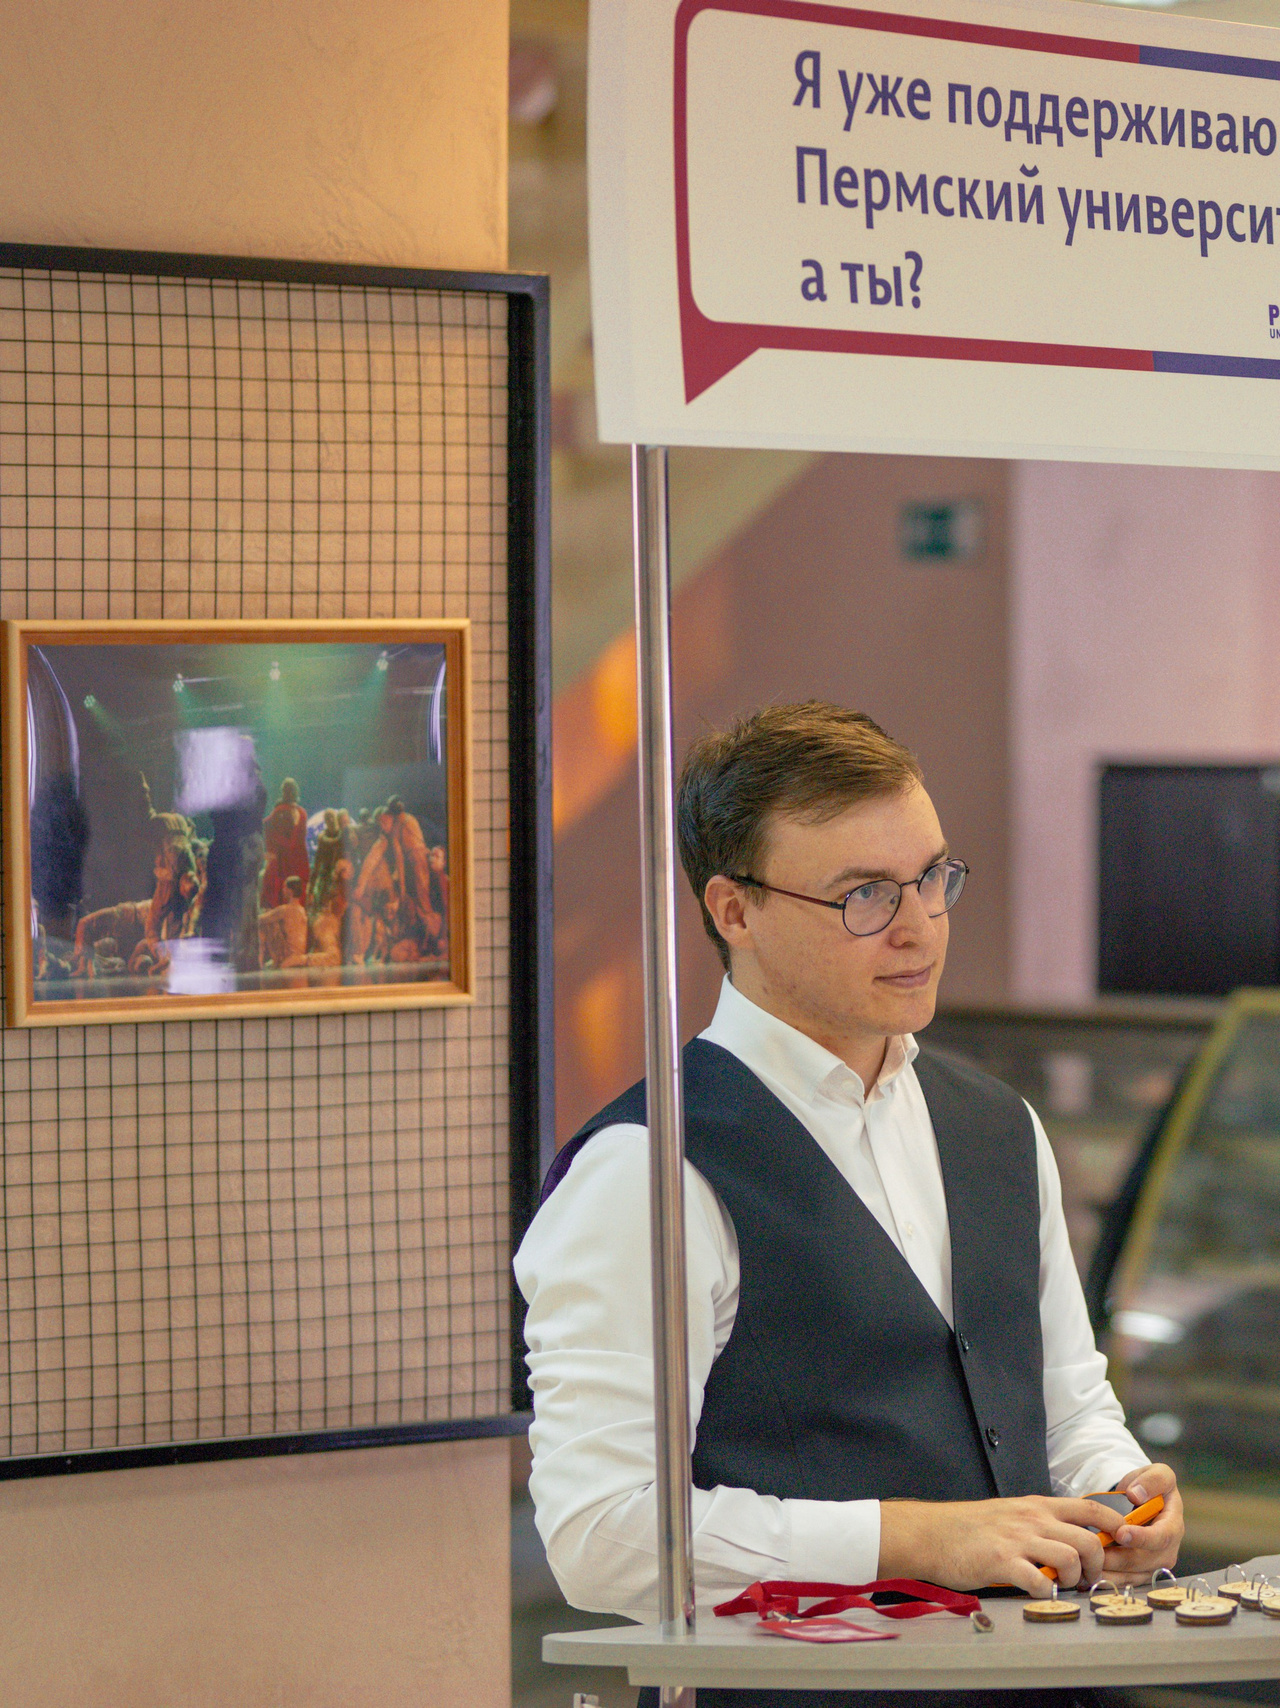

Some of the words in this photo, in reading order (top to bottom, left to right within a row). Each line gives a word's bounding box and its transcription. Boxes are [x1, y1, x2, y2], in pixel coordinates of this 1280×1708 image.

[793, 49, 821, 108] Я
[838, 70, 933, 131] уже
[948, 83, 1278, 158] поддерживаю
[796, 146, 1045, 229] Пермский
[800, 259, 828, 302] а
[841, 250, 923, 309] ты?
